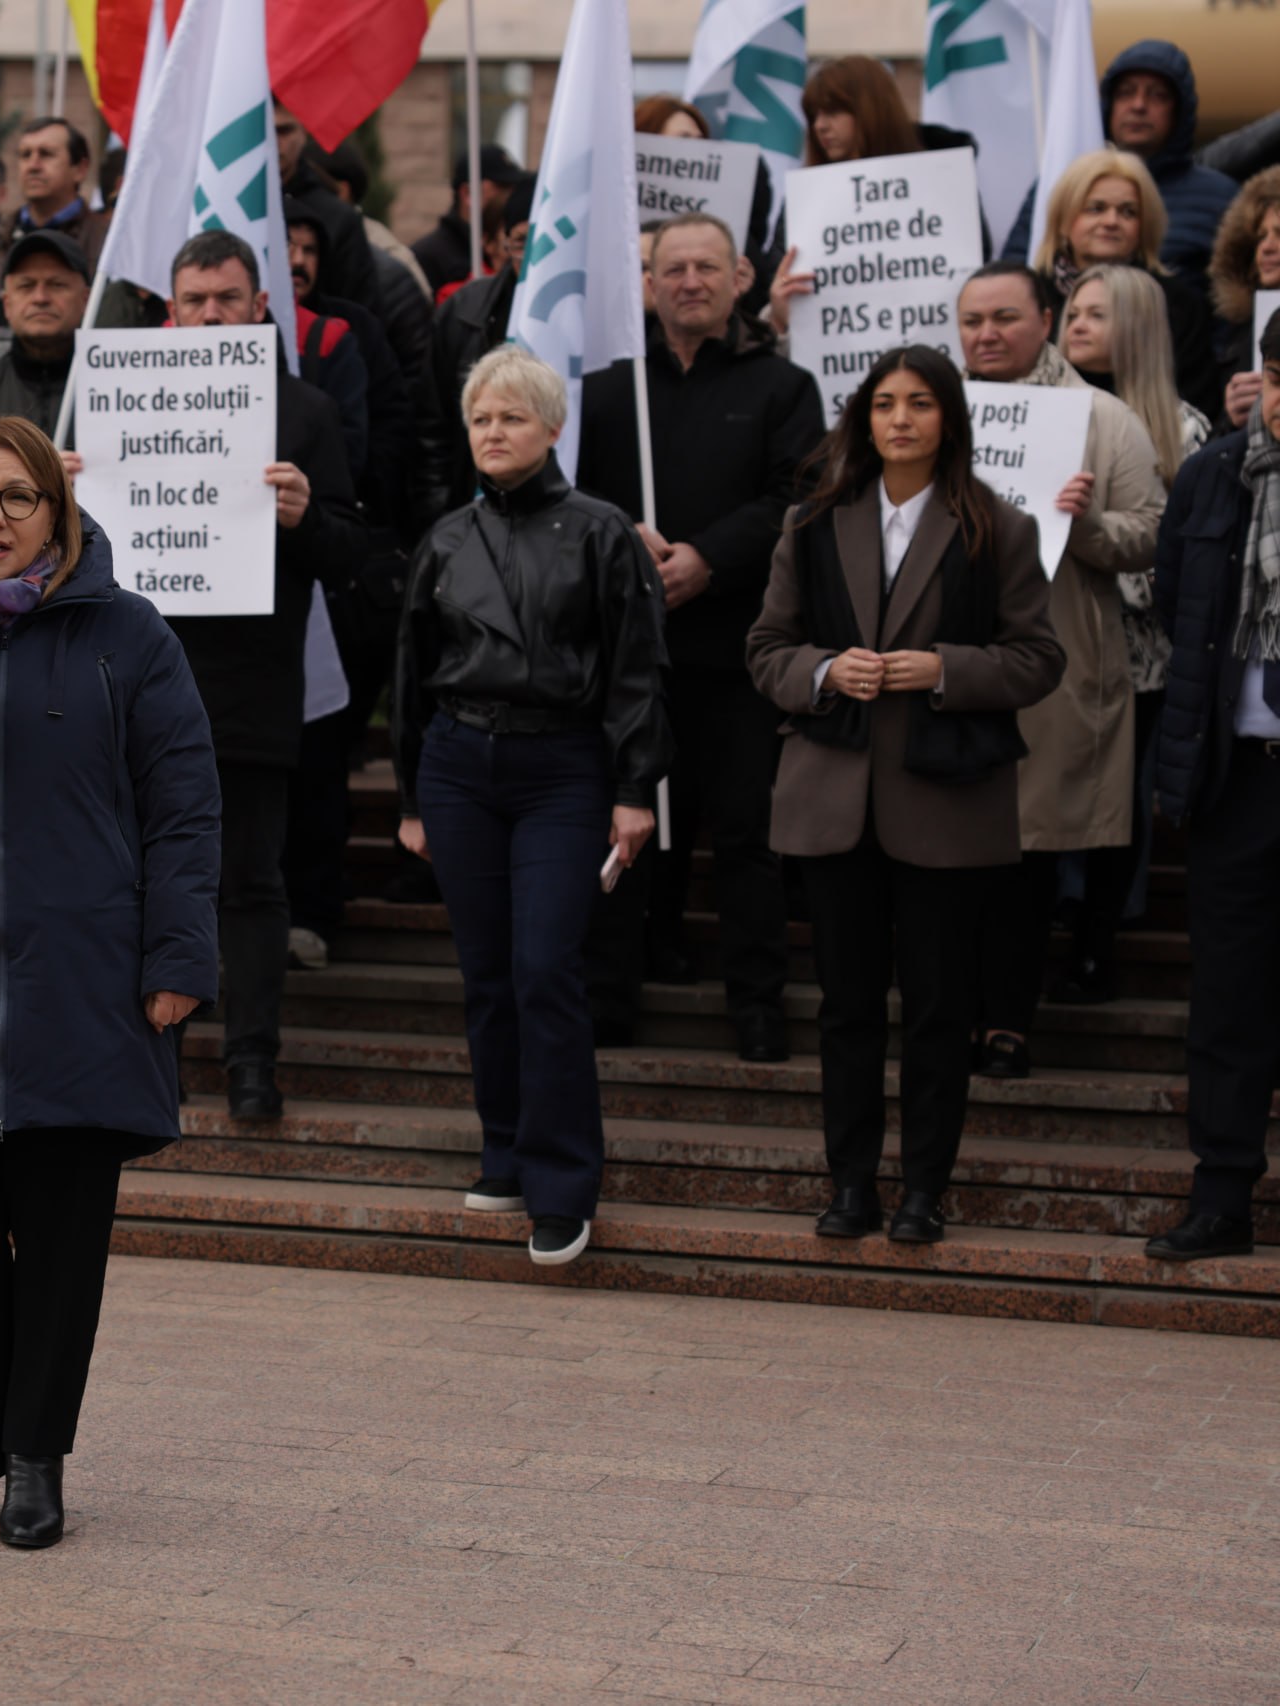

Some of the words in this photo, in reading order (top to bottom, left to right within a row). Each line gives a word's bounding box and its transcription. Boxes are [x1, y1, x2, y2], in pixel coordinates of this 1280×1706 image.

[636, 152, 722, 182] amenii
[638, 181, 708, 213] lătesc
[850, 175, 910, 213] Țara
[823, 220, 900, 255] geme
[908, 208, 942, 238] de
[813, 253, 955, 294] probleme,
[822, 303, 870, 335] PAS
[877, 308, 892, 329] e
[900, 303, 948, 334] pus
[87, 345, 212, 369] Guvernarea
[219, 340, 266, 365] PAS:
[89, 389, 109, 412] în
[116, 389, 147, 412] loc
[152, 387, 178, 411] de
[184, 385, 249, 416] soluții
[981, 401, 1029, 431] poți
[120, 429, 230, 462] justificări,
[972, 444, 1026, 468] strui
[130, 482, 149, 506] în
[157, 482, 187, 505] loc
[192, 481, 218, 505] de
[131, 524, 207, 556] acțiuni
[135, 569, 212, 592] tăcere.
